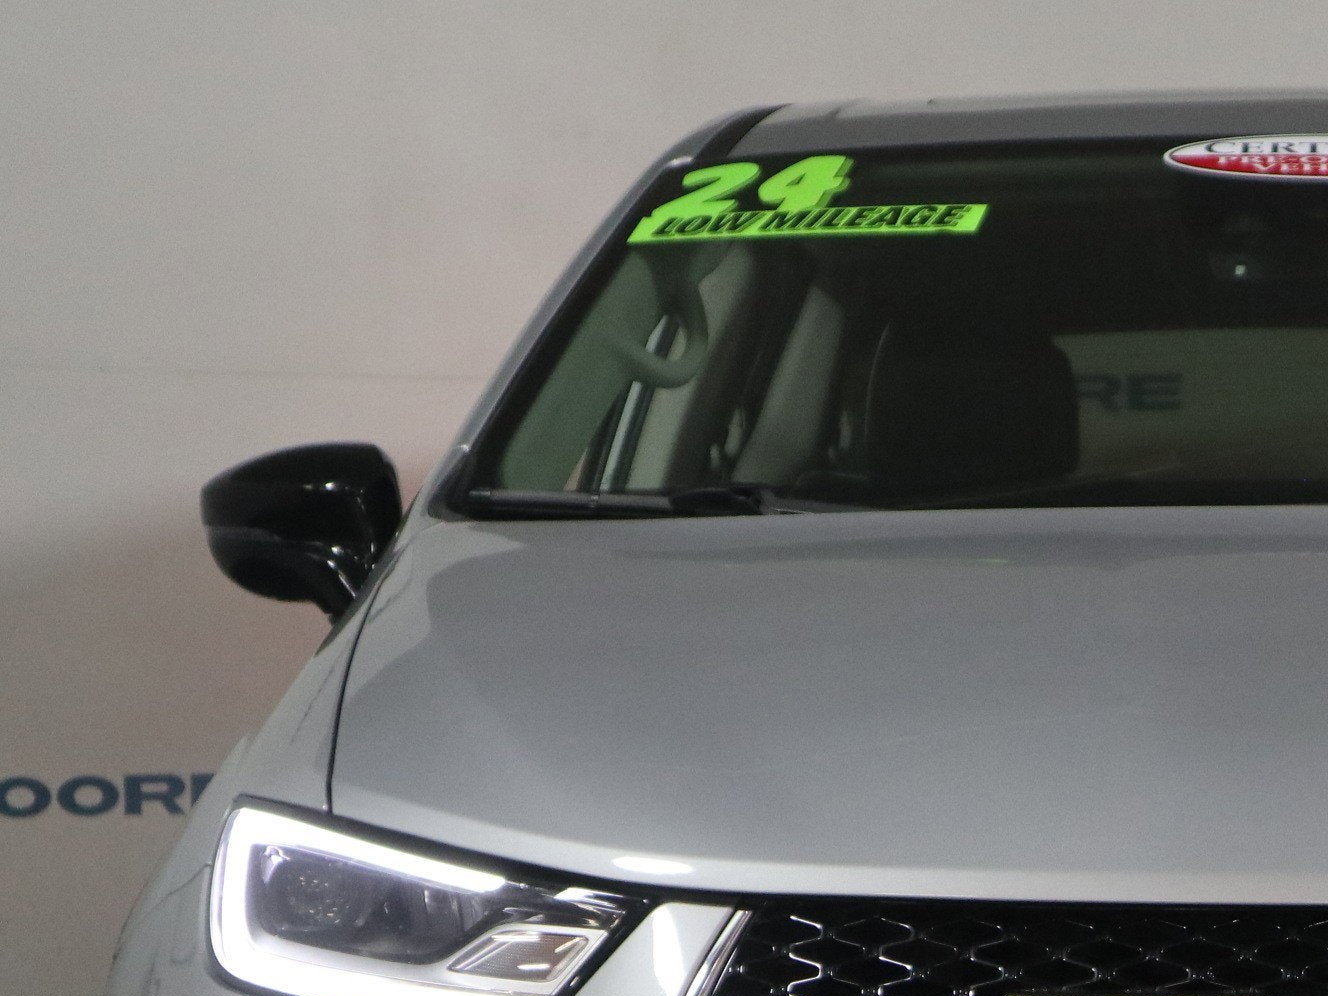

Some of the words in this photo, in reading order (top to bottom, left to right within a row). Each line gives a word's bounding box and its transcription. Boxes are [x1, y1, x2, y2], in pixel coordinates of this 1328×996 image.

[651, 155, 852, 215] 24
[650, 210, 765, 236] LOW
[757, 204, 972, 232] MILEAGE
